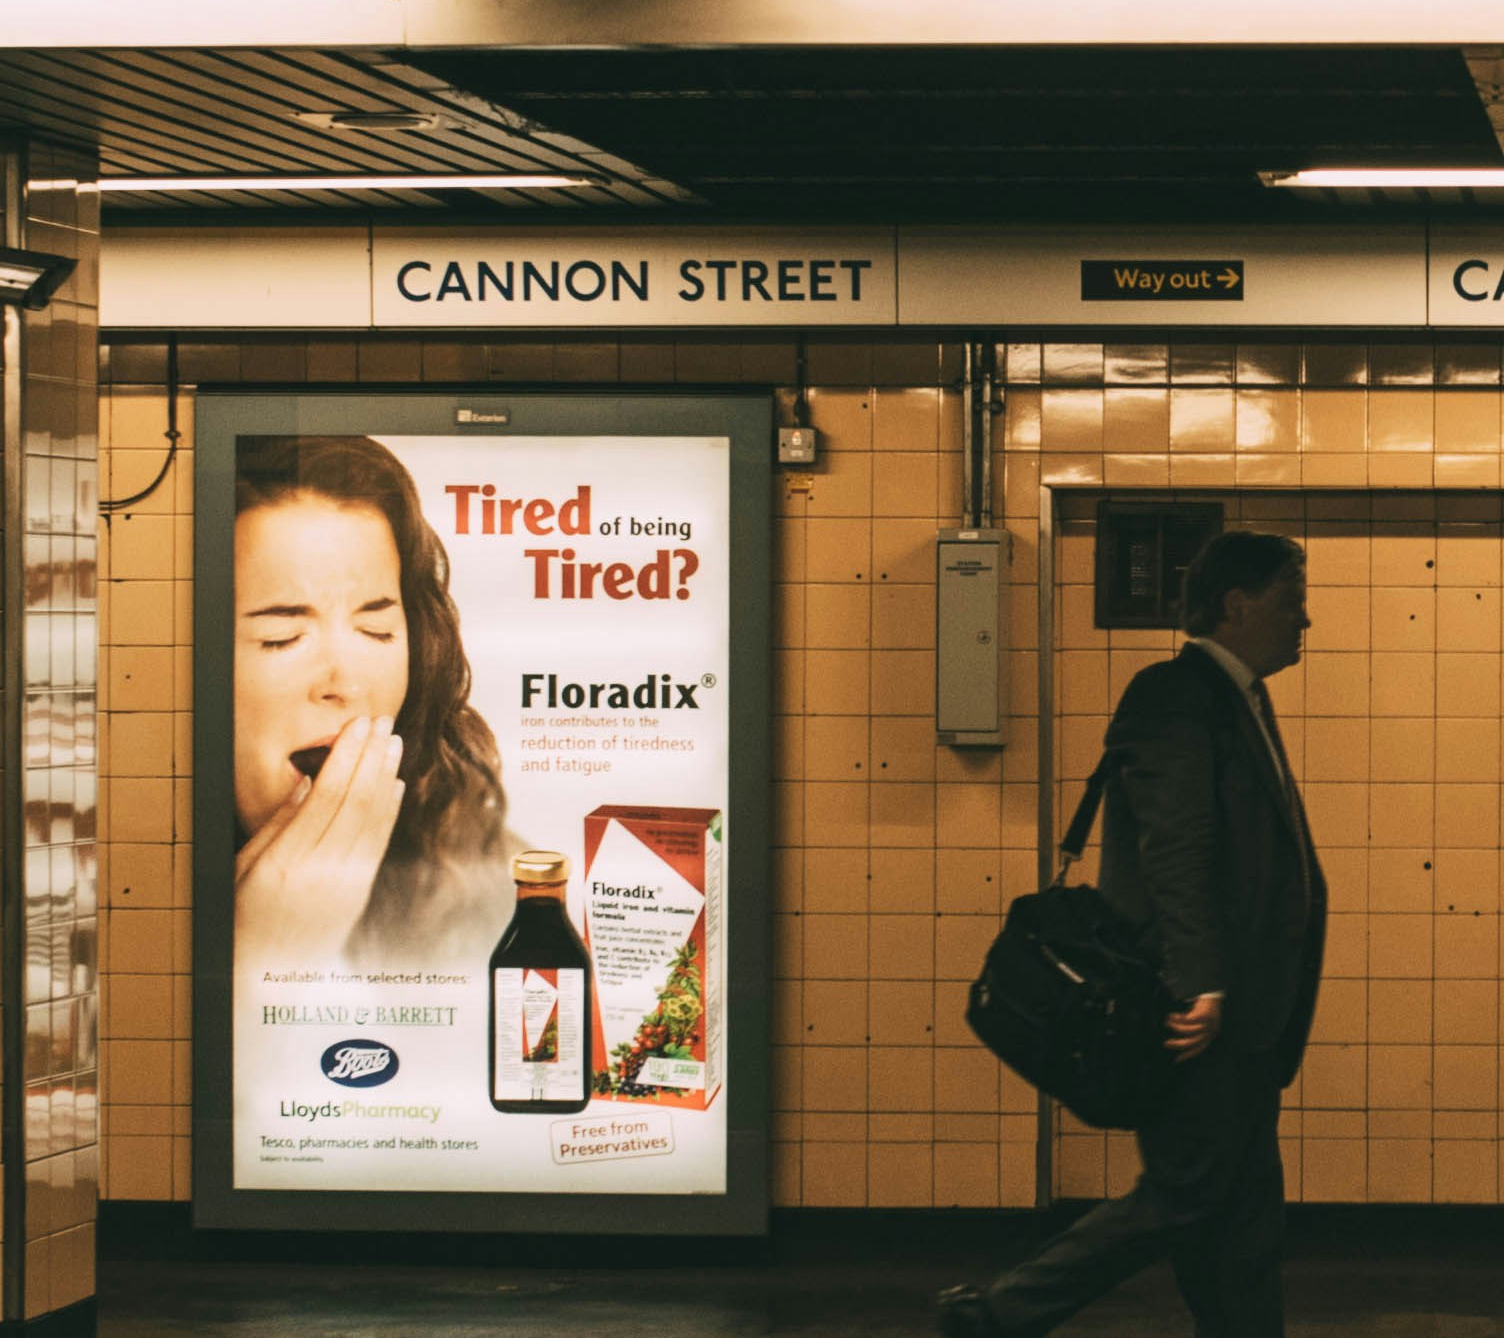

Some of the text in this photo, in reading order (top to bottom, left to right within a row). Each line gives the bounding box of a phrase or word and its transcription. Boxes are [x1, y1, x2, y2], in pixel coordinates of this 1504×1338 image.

[396, 260, 873, 303] CANNON STREET
[1113, 268, 1212, 294] Way out
[444, 484, 692, 541] Tired of being
[523, 548, 700, 601] Tired?
[521, 716, 659, 727] iron contributes to the
[521, 735, 695, 751] reduction of tiredness
[521, 758, 612, 776] and fatigue
[592, 881, 655, 900] Floradix
[643, 904, 658, 912] and
[663, 906, 695, 915] vitamin
[263, 972, 470, 985] Available from selected stores:
[262, 1005, 458, 1026] HOLLAND & BARRETT
[327, 1046, 391, 1080] Boots
[280, 1100, 443, 1124] LloydsPharmacy
[572, 1122, 649, 1139] Free from
[260, 1136, 479, 1152] Tesco, pharmacies and health stores
[560, 1137, 668, 1158] Preservatives
